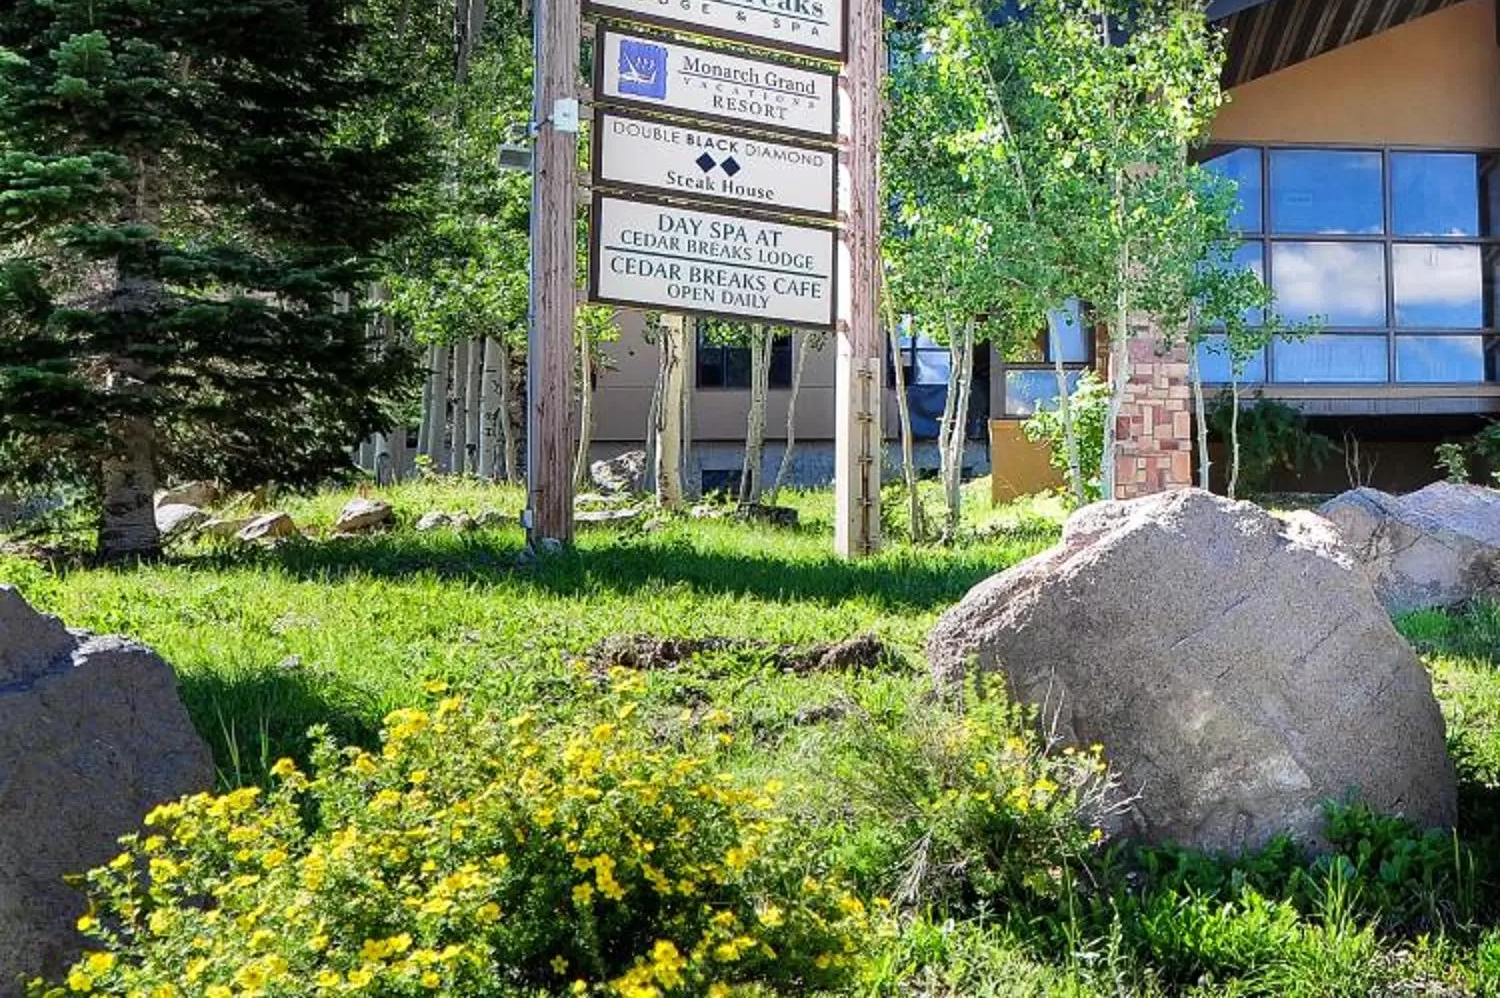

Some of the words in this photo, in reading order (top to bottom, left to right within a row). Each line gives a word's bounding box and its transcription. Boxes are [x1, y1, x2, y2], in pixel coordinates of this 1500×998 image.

[736, 11, 746, 22] &
[773, 18, 818, 35] SPA
[683, 56, 758, 84] Monarch
[764, 72, 815, 94] Grand
[713, 96, 789, 120] RESORT
[613, 122, 680, 145] DOUBLE
[686, 134, 739, 152] BLACK
[745, 144, 824, 167] DIAMOND
[666, 171, 715, 190] Steak
[723, 180, 774, 200] House
[659, 214, 703, 236] DAY
[710, 222, 747, 243] SPA
[756, 230, 783, 247] AT
[621, 230, 680, 251] CEDAR
[687, 239, 753, 261] BREAKS
[759, 250, 814, 270] LODGE
[611, 256, 681, 281] CEDAR
[689, 267, 766, 291] BREAKS
[774, 278, 821, 298] CAFE
[668, 284, 714, 303] OPEN
[722, 291, 771, 309] DAILY
